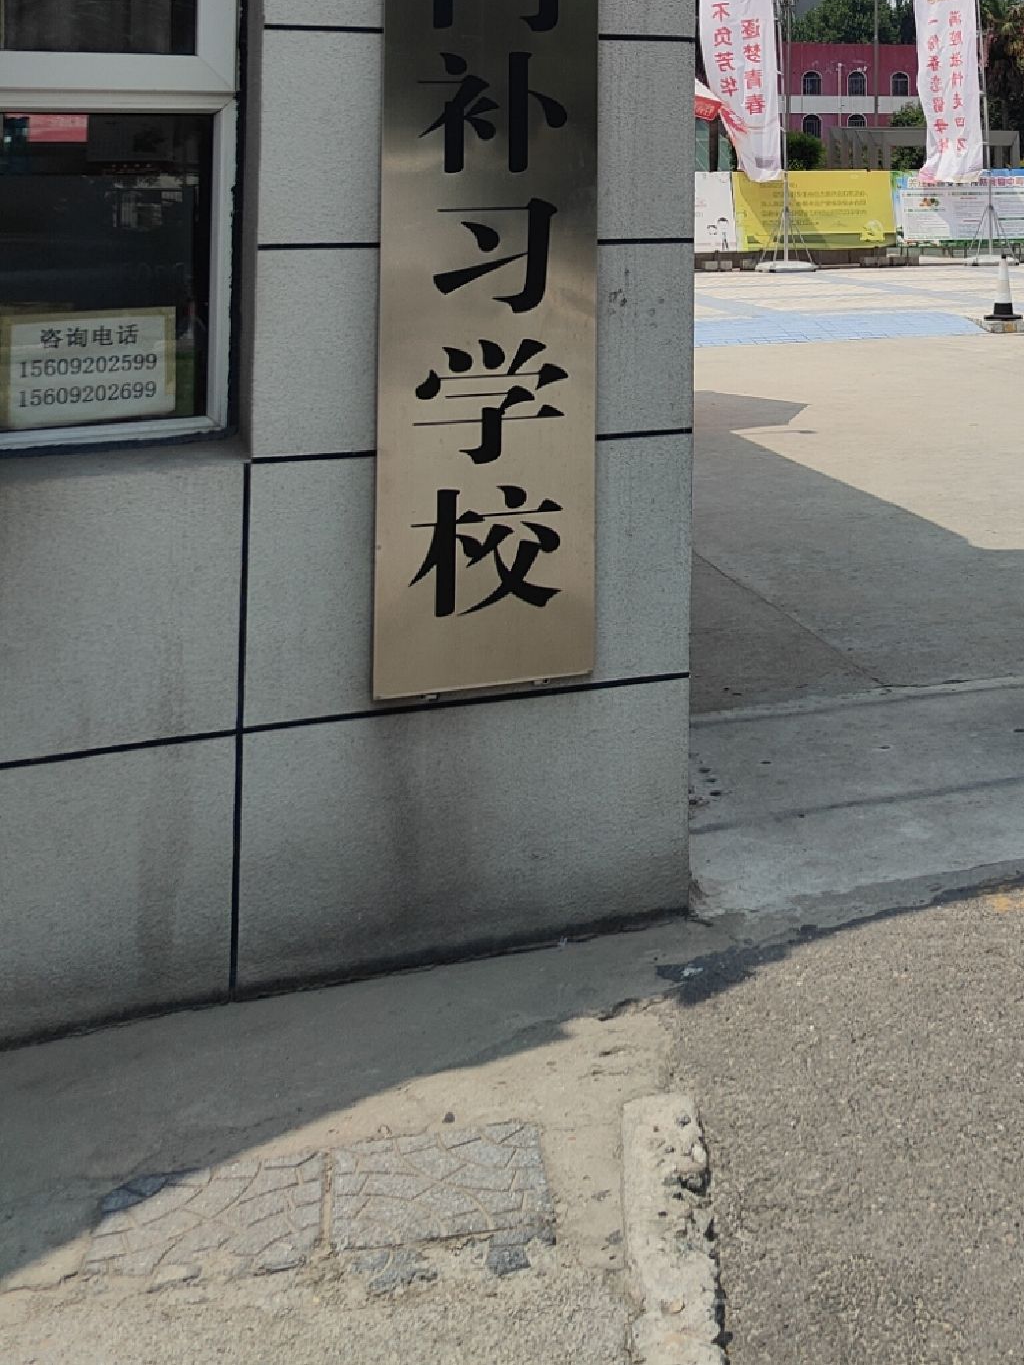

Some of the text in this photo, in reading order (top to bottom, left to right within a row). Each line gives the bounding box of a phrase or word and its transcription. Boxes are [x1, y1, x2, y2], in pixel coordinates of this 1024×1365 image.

[40, 324, 140, 349] 咨询电话
[19, 353, 158, 379] 15609202599
[19, 380, 157, 408] 15609202699
